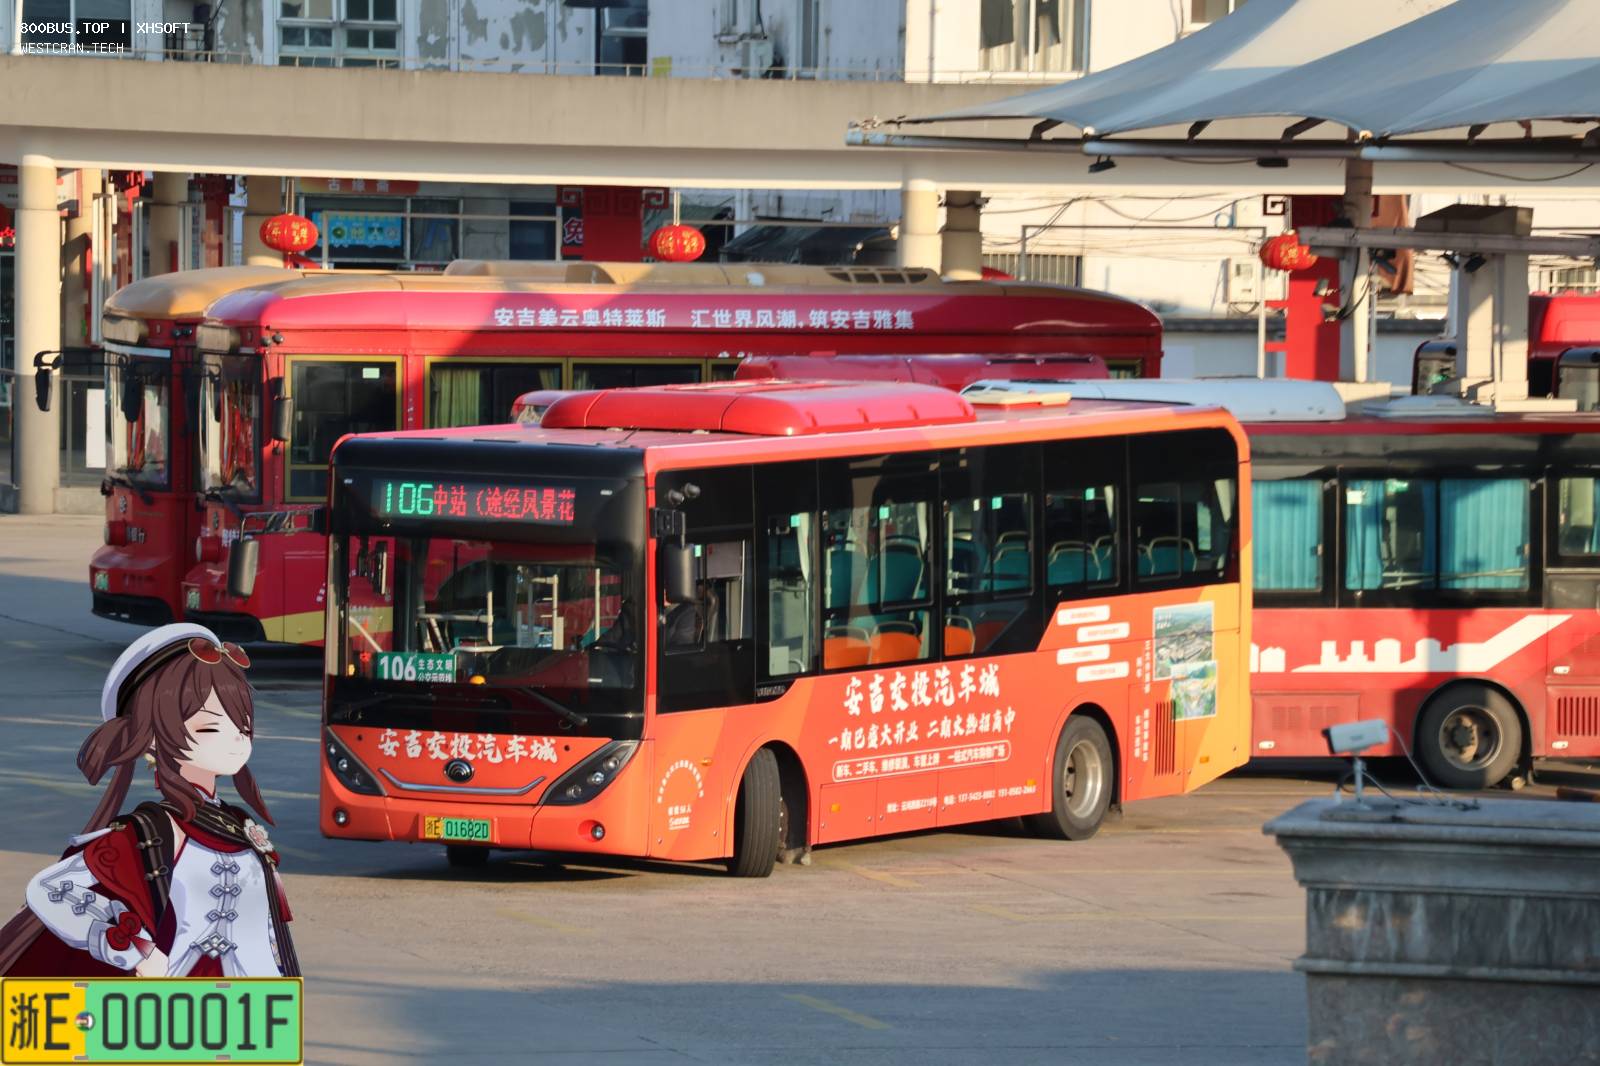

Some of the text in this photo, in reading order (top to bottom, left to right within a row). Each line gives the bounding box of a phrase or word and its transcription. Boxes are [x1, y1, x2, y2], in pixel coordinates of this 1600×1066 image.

[494, 307, 666, 328] 安吉美云奥特莱斯
[385, 482, 433, 515] 106
[380, 654, 417, 681] 106
[417, 658, 453, 671] 生态文明
[843, 663, 1001, 716] 安吉交投汽车城
[828, 705, 1017, 752] 一期已盛大开业 二期火热招商中
[378, 728, 558, 764] 安吉交投汽车城
